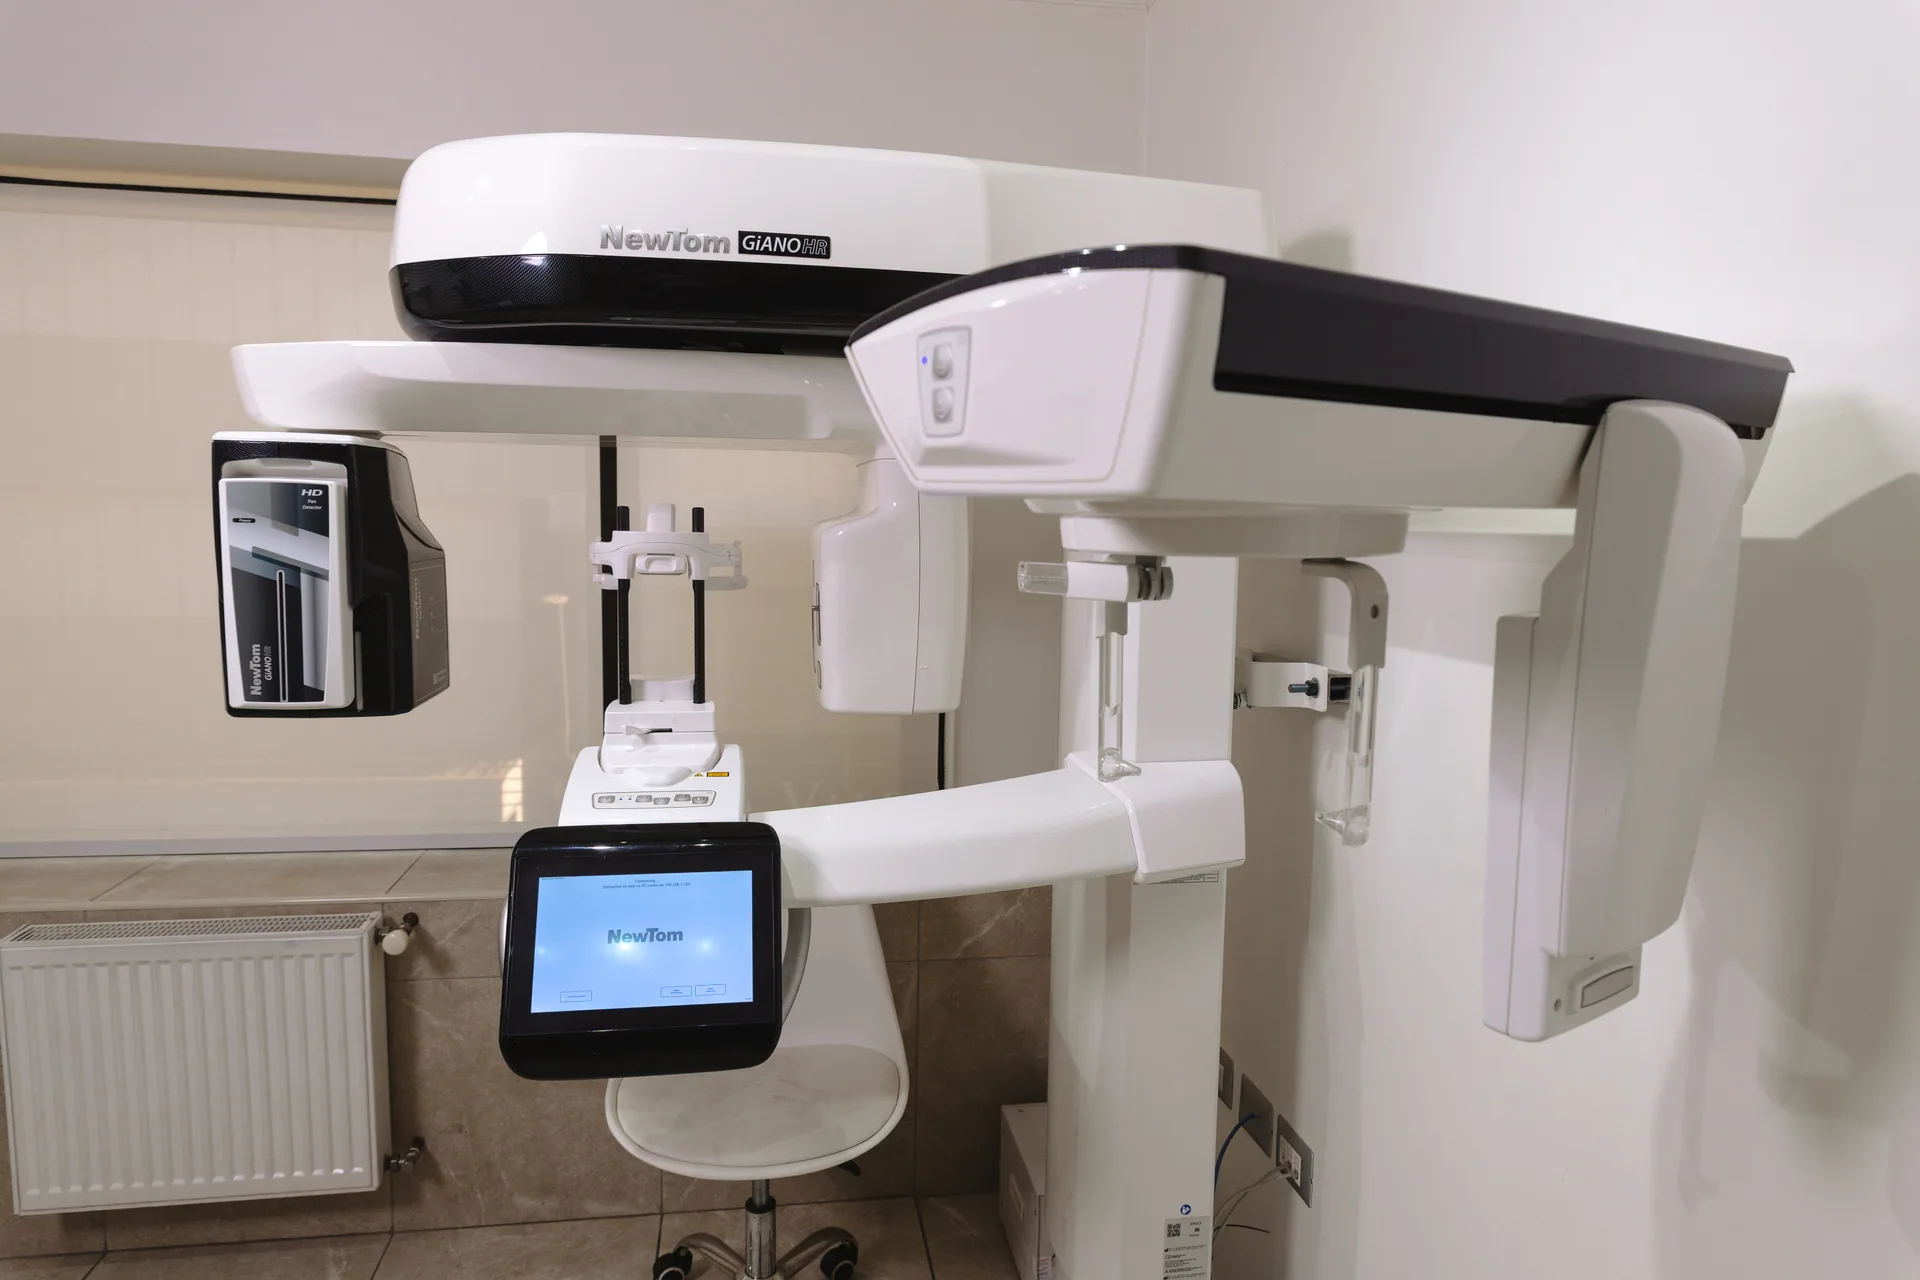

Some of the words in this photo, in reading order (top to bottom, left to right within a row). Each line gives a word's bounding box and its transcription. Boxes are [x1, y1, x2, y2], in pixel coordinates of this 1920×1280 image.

[600, 224, 731, 253] NewTom
[301, 489, 323, 497] HD
[249, 644, 262, 695] NewTom
[607, 927, 684, 944] NewTom
